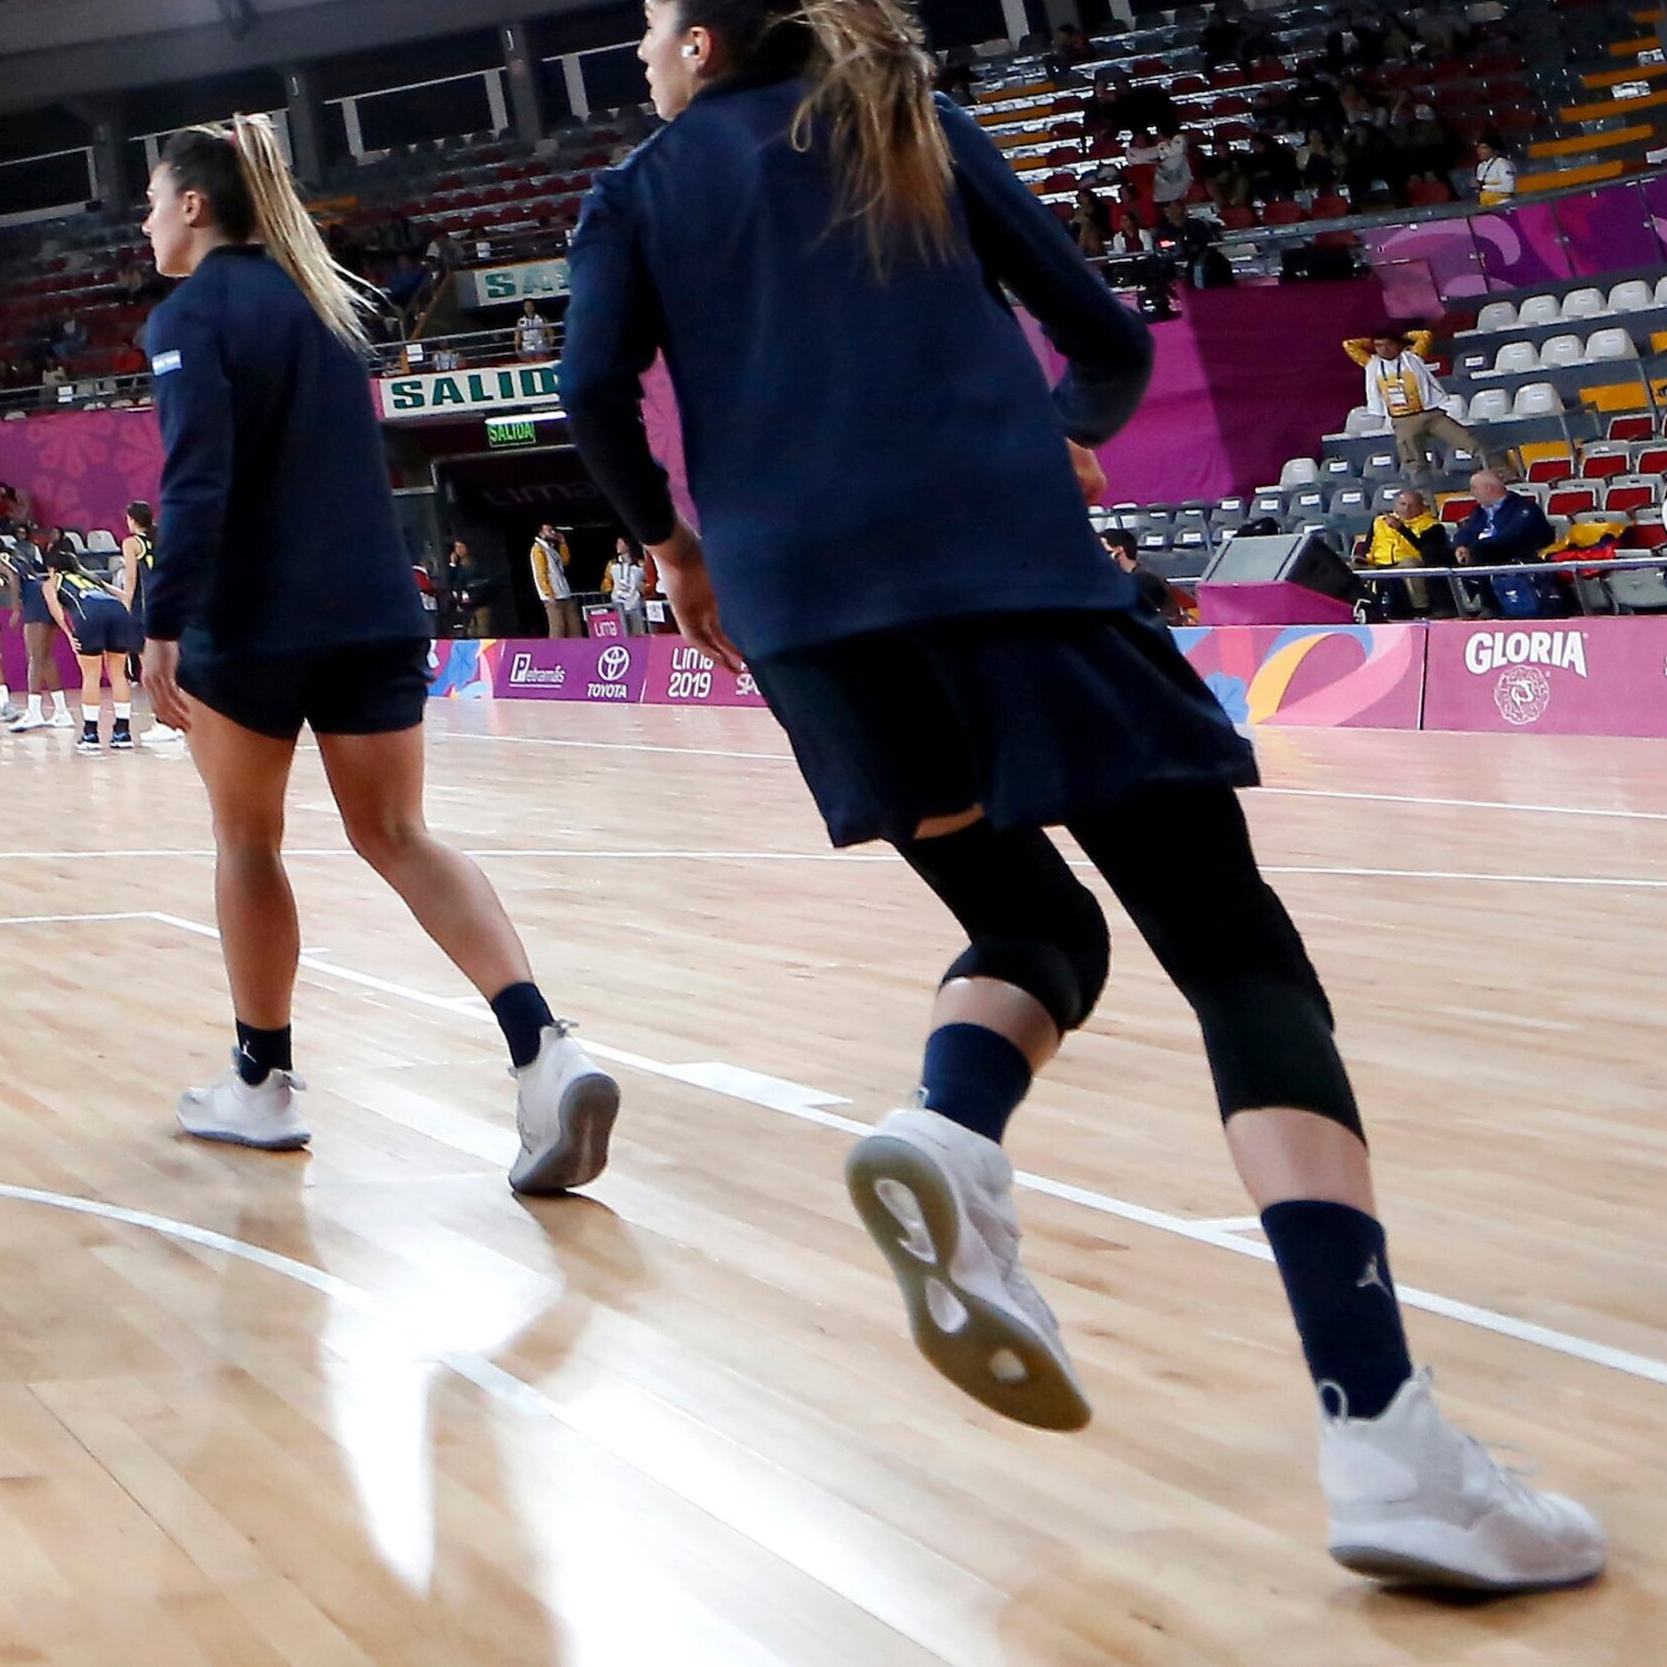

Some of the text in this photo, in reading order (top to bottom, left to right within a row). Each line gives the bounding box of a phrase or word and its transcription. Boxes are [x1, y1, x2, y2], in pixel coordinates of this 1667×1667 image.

[391, 367, 560, 409] SALID
[489, 421, 534, 443] SALIDA
[1465, 631, 1587, 678] GLORIA
[587, 682, 627, 698] TOYOTA
[668, 671, 713, 698] 2019
